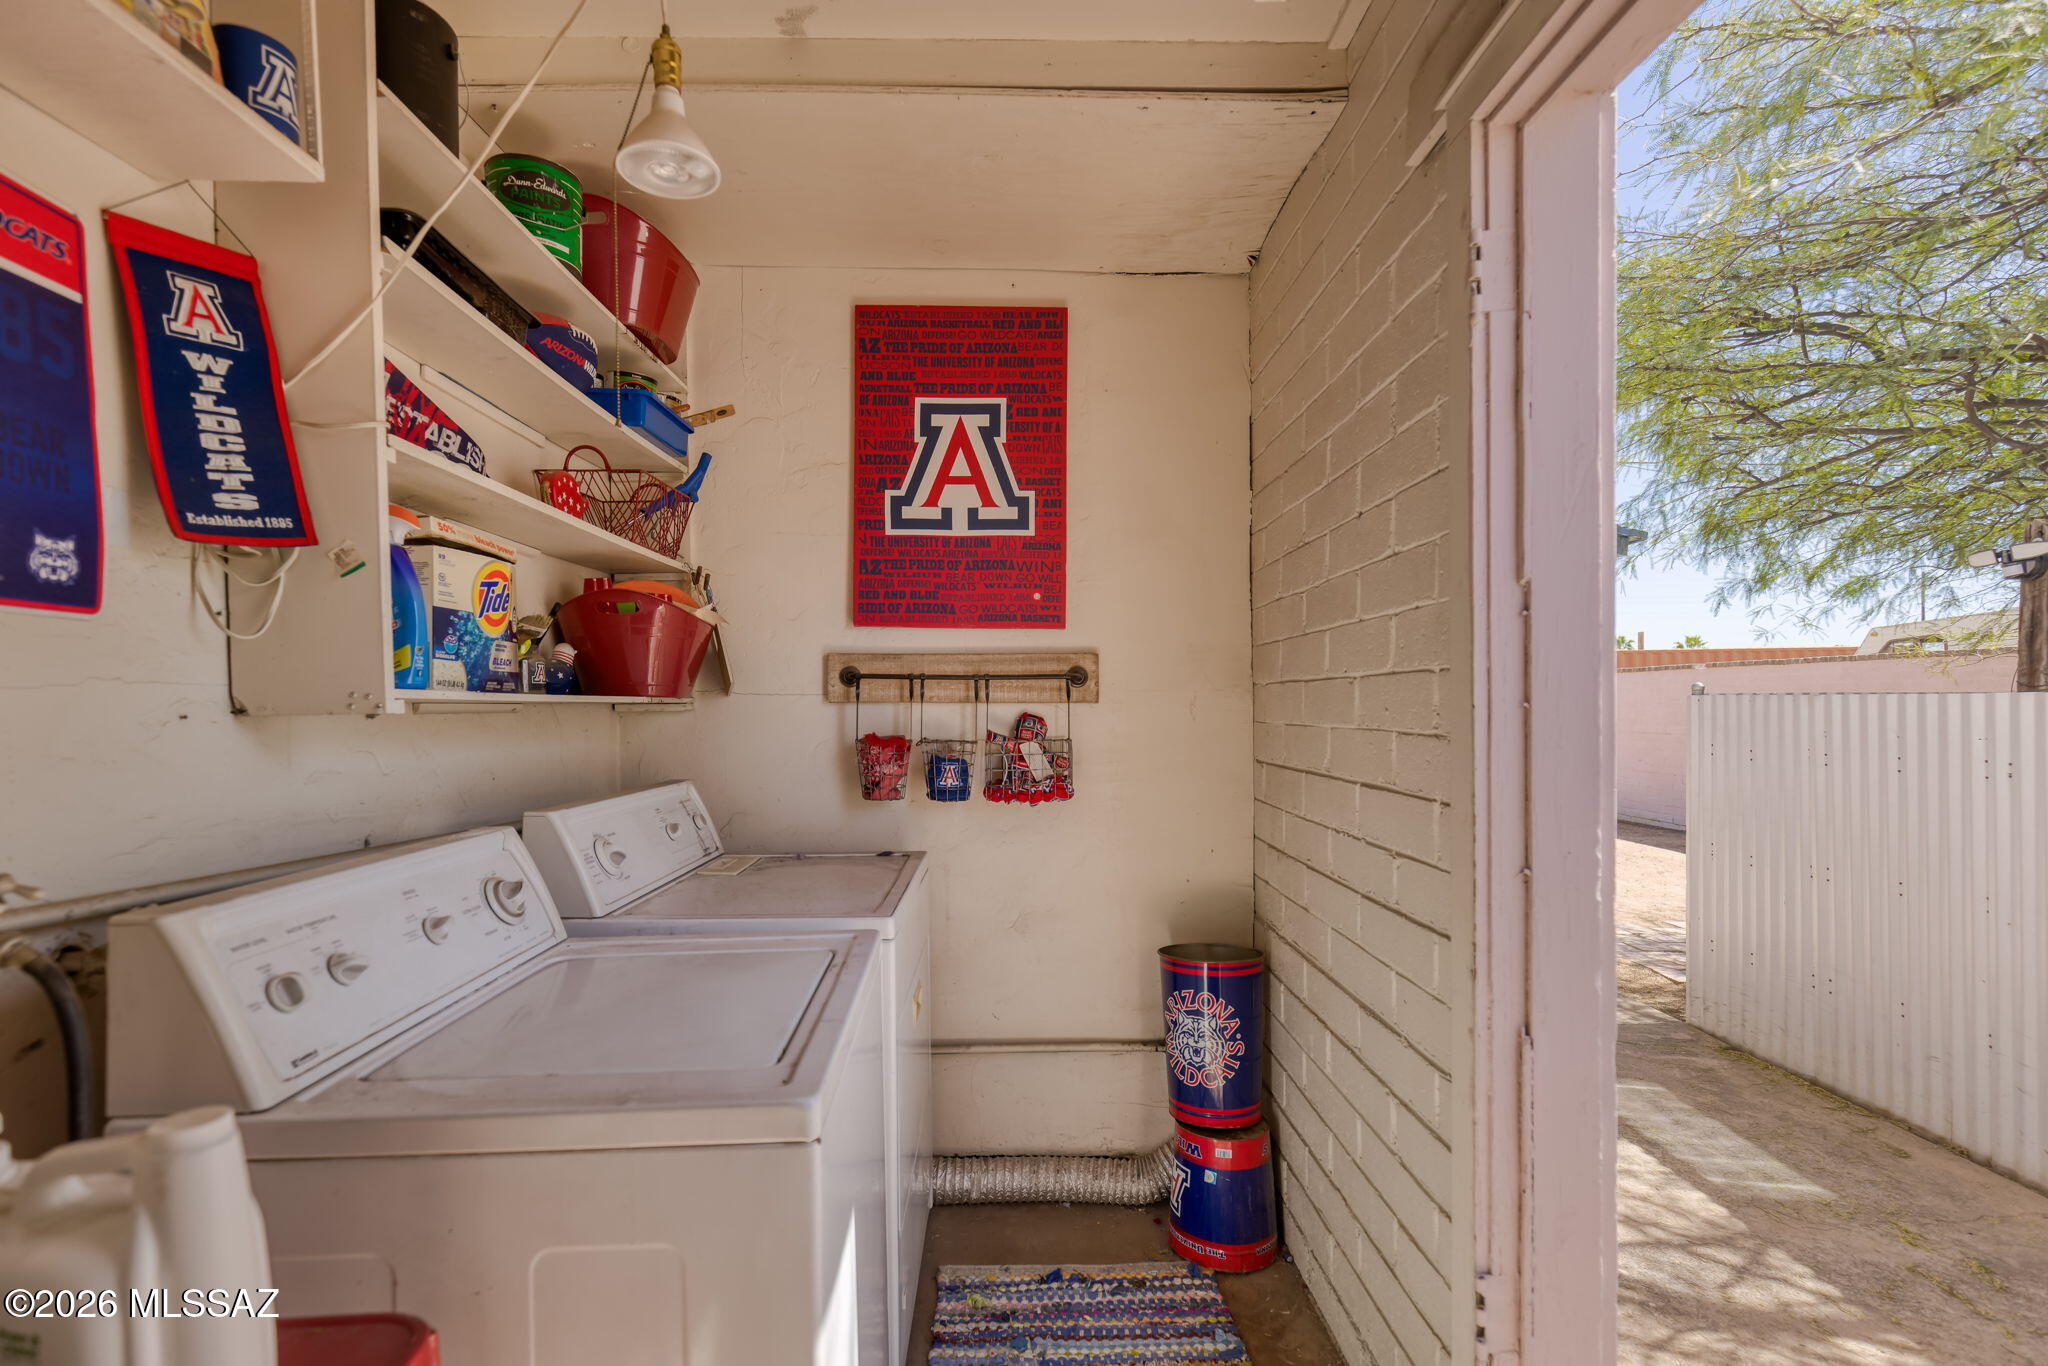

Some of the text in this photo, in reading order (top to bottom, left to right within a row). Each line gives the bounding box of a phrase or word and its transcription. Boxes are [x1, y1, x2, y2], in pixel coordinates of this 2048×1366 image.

[503, 175, 567, 200] Dunn-Edwards
[511, 187, 561, 209] PAINTS
[0, 210, 68, 260] CATS
[162, 270, 244, 352] A
[887, 320, 928, 328] ARIZONA
[930, 320, 992, 329] BASKETBALL
[992, 320, 1015, 329] RED
[1018, 320, 1042, 329] AND
[882, 330, 919, 341] ARIZONA
[958, 331, 977, 340] GO
[859, 338, 881, 353] AZ
[883, 342, 908, 353] THE
[910, 342, 947, 353] PRIDE
[949, 342, 965, 353] OF
[966, 343, 1018, 354] ARIZONA
[1018, 342, 1048, 351] BEAR
[540, 337, 586, 369] ARIZONA
[912, 356, 929, 368] THE
[931, 356, 982, 368] UNIVERSITY
[984, 356, 996, 368] OF
[998, 357, 1035, 368] ARIZONA
[860, 371, 883, 381] AND
[886, 371, 916, 381] BLUE
[1018, 371, 1063, 380] WILDCATS
[914, 383, 938, 394] THE
[940, 383, 976, 394] PRIDE
[978, 383, 994, 394] OF
[995, 383, 1047, 395] ARIZONA
[859, 395, 910, 406] OF ARIZONA
[1008, 395, 1051, 404] WILDCATS
[1015, 408, 1039, 417] RED
[181, 350, 260, 511] WILDCATS
[1042, 422, 1053, 433] OF
[859, 454, 908, 465] ARIZONA
[884, 397, 1036, 536] A
[876, 477, 902, 492] AZ
[1024, 478, 1062, 486] BASKET
[186, 512, 294, 529] Established 1885
[436, 522, 457, 535] 50%
[870, 536, 885, 548] THE
[888, 536, 939, 548] UNIVERSITY
[941, 536, 954, 548] OF
[954, 537, 991, 548] ARIZONA
[1022, 543, 1062, 551] ARIZONA
[898, 549, 940, 559] WILDCATS
[941, 550, 979, 559] ARIZONA
[859, 559, 882, 575] AZ
[882, 559, 906, 570] THE
[908, 559, 945, 571] PRIDE
[947, 560, 962, 571] OF
[963, 559, 1016, 571] ARIZONA
[945, 572, 976, 582] BEAR
[979, 572, 1013, 581] DOWN
[1016, 573, 1036, 582] GO
[859, 578, 895, 589] ARIZONA
[933, 582, 977, 592] WILDCATS
[478, 580, 510, 619] Tide
[858, 590, 881, 600] RED
[884, 590, 907, 600] AND
[909, 590, 940, 600] BLUE
[858, 603, 885, 614] RIDE
[887, 603, 903, 614] OF
[904, 603, 956, 615] ARIZONA
[958, 604, 979, 614] GO
[977, 614, 1017, 623] ARIZONA
[492, 657, 512, 667] BLEACH
[532, 661, 547, 684] A
[937, 762, 960, 788] A
[1165, 989, 1241, 1040] ARIZONA
[1165, 1037, 1246, 1089] WILDCATS
